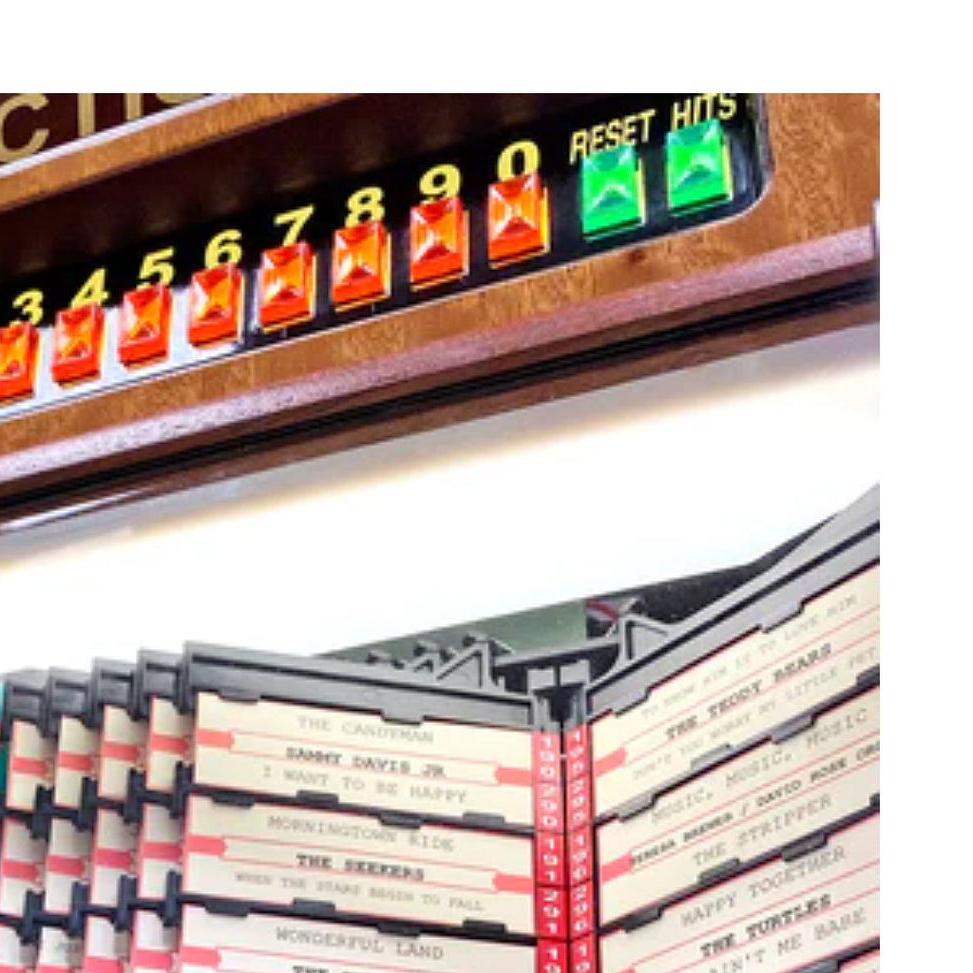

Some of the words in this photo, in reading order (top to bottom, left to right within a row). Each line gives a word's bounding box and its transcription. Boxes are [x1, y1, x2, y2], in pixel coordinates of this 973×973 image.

[570, 108, 657, 165] RESET
[671, 93, 738, 131] HITS
[496, 140, 540, 183] 0
[418, 163, 462, 204] 9
[273, 206, 314, 247] 7
[344, 187, 385, 228] 8
[136, 246, 175, 290] 5
[204, 228, 243, 269] 6
[11, 289, 44, 326] 3
[69, 268, 110, 310] 4
[665, 714, 698, 741] THE
[707, 679, 763, 718] TEDDY
[772, 642, 832, 682] BEARS
[297, 714, 333, 734] THE
[341, 720, 435, 744] CANDYMAN
[726, 751, 793, 788] MUSIC,
[806, 707, 869, 749] MUSIC
[285, 746, 343, 767] SAMMY
[352, 754, 411, 774] DAVIS
[421, 762, 447, 778] JR
[263, 765, 272, 779] I
[282, 768, 329, 790] WANT
[341, 775, 366, 792] TO
[375, 780, 399, 798] BE
[409, 785, 469, 806] HAPPY
[267, 814, 398, 844] MORNINGTOWN
[407, 833, 455, 853] RIDE
[693, 841, 728, 867] THE
[738, 795, 833, 842] STRIPPER
[295, 853, 333, 870] THE
[344, 857, 426, 882] SEEKERS
[681, 893, 738, 929] HAPPY
[747, 845, 847, 897] TOGETHER
[280, 876, 308, 891] THE
[422, 892, 440, 906] TO
[448, 896, 485, 912] FALL
[275, 926, 386, 955] WONDERFUL
[395, 940, 445, 961] LAND
[700, 933, 735, 958] THE
[745, 893, 832, 940] TURTLES
[777, 932, 803, 956] ME
[814, 908, 868, 940] BABE
